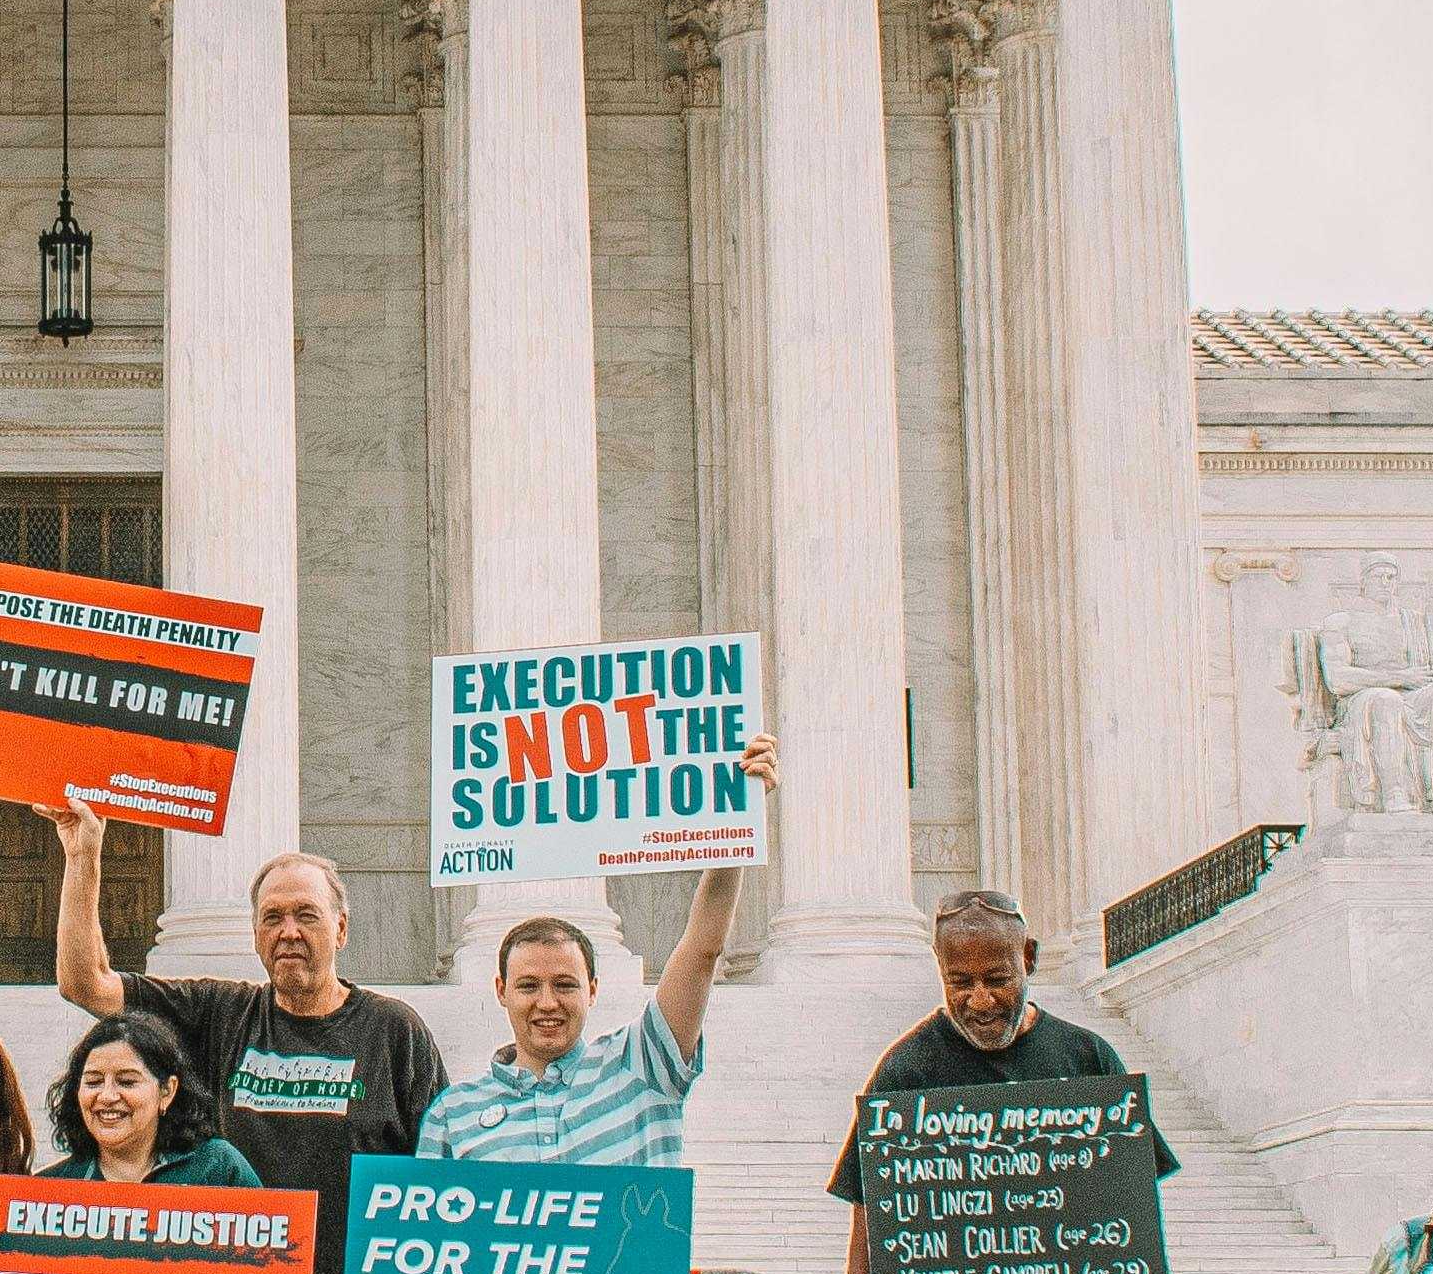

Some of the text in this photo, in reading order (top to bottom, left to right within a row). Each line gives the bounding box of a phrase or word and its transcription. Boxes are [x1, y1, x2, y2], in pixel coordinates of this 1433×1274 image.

[48, 603, 83, 626] THE
[88, 610, 151, 637] DEATH
[156, 621, 241, 651] PENALTY
[35, 667, 98, 704] KILL
[109, 681, 168, 715] FOR
[177, 691, 235, 727] ME!
[453, 644, 742, 714] EXECUTION
[453, 695, 745, 783] IS NOT THE
[110, 773, 216, 803] #StopExecutions
[452, 762, 747, 829] SOLUTION
[599, 846, 754, 866] DeathPenaltyAction.org
[642, 828, 754, 845] #StopExecutions
[440, 847, 513, 874] ACTION
[868, 1091, 1137, 1143] In loving memory of
[895, 1152, 1040, 1184] MARTIN RICHARD
[7, 1201, 288, 1248] EXECUTE JUSTICE
[364, 1183, 604, 1227] PRO-LIFE
[895, 1192, 918, 1221] LU
[898, 1231, 947, 1263] SEAN
[965, 1226, 1045, 1257] COLLIER
[1087, 1218, 1130, 1248] 26)
